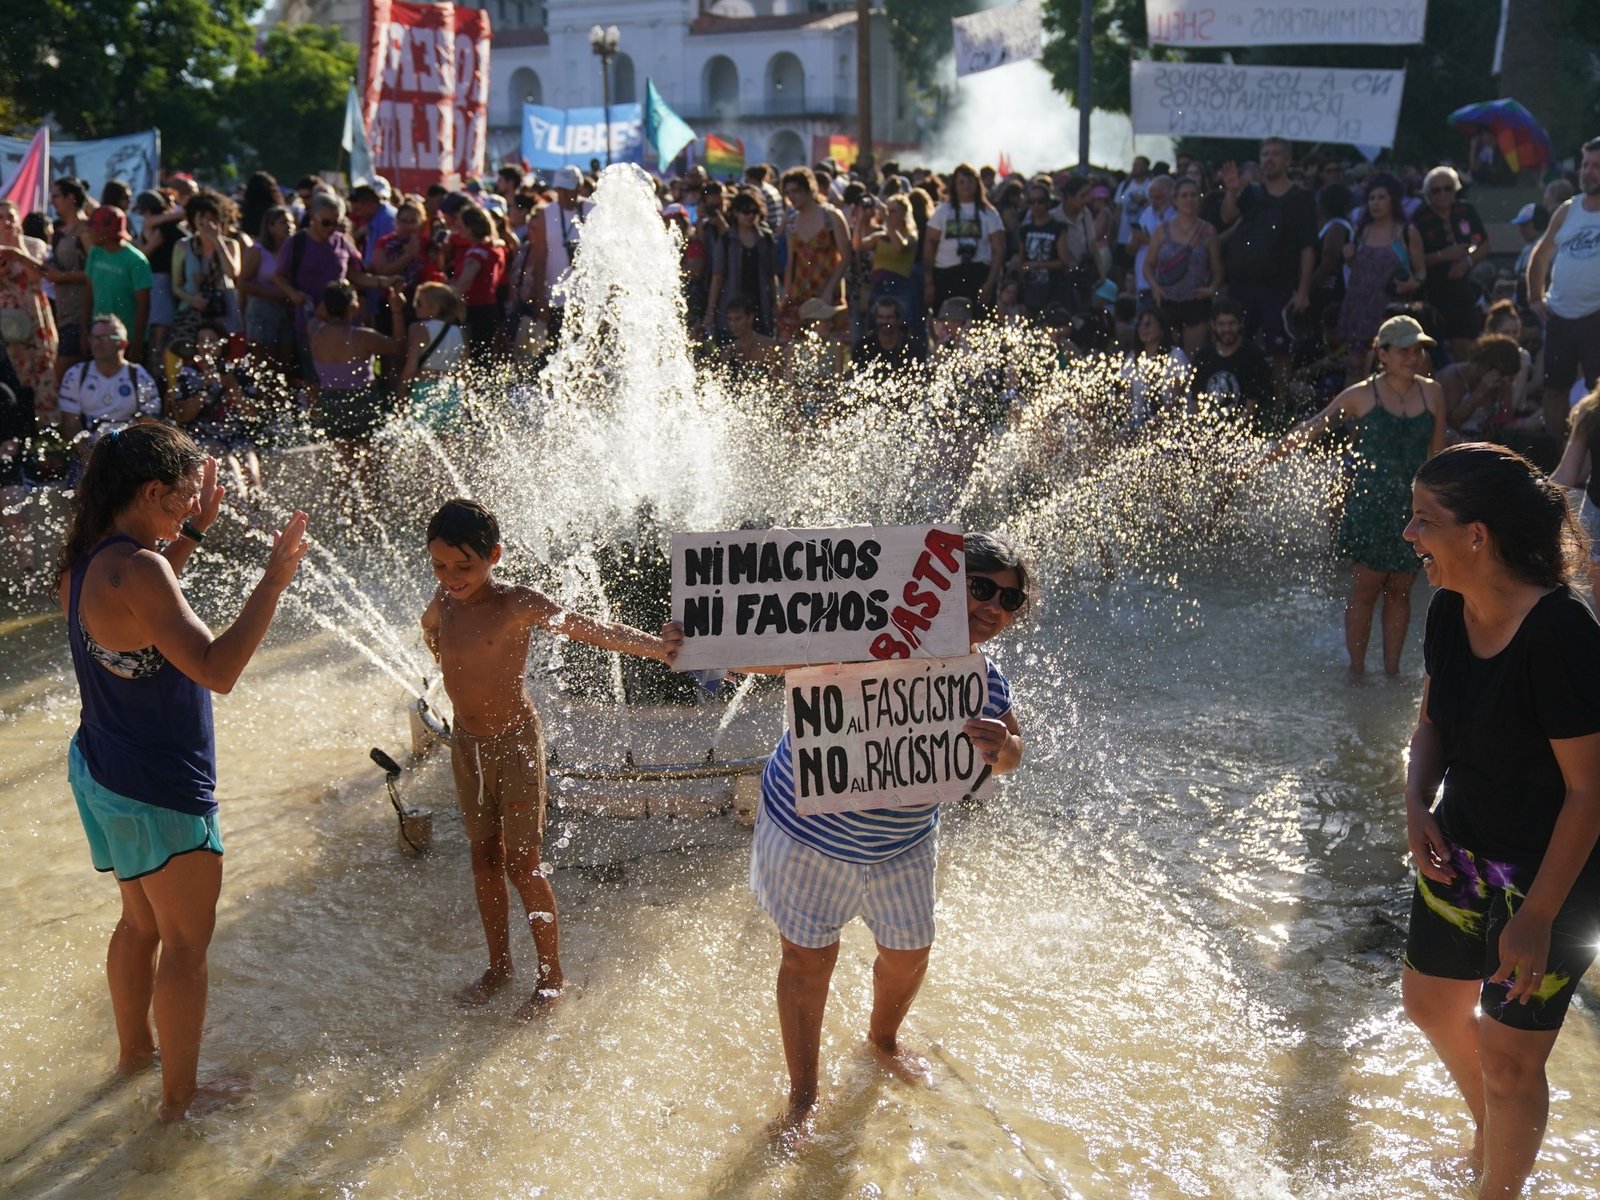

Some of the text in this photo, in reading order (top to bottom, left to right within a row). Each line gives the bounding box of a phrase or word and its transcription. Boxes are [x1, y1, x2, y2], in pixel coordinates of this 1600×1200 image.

[728, 538, 882, 585] MACHOS
[736, 589, 890, 636] FACHOS
[869, 529, 964, 660] BASTA
[791, 684, 845, 739] NO
[861, 666, 984, 733] FASCISMO
[800, 746, 850, 798] NO
